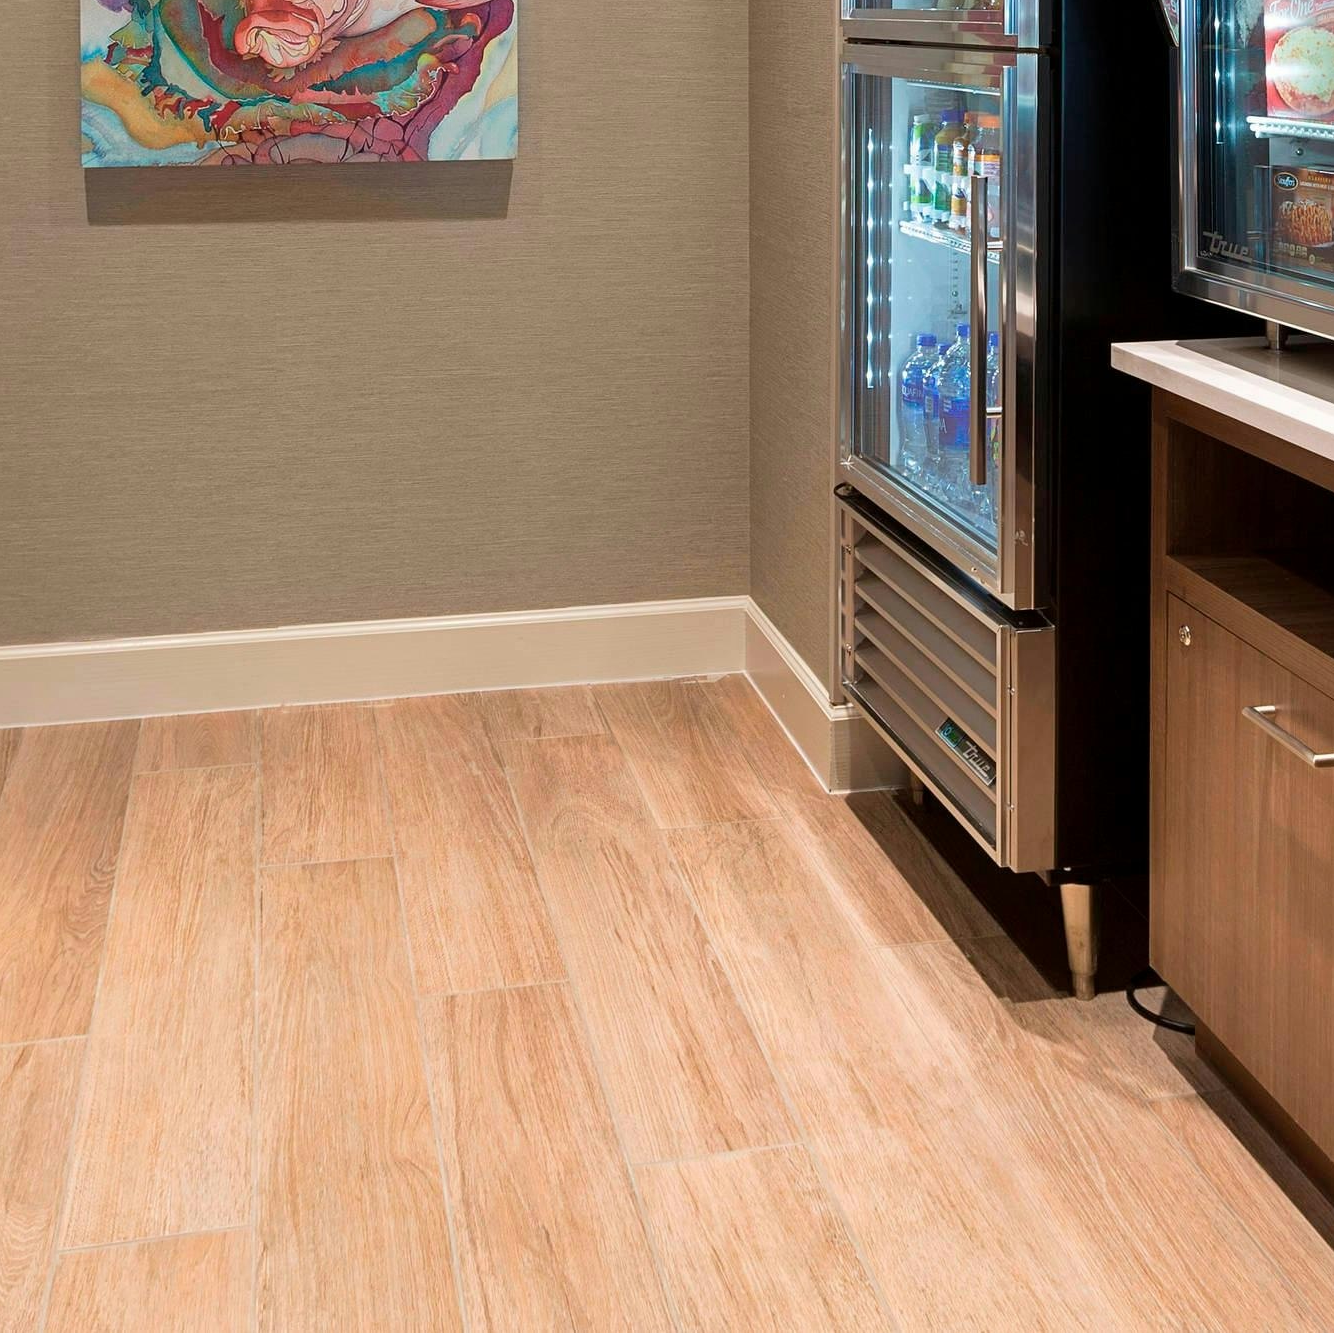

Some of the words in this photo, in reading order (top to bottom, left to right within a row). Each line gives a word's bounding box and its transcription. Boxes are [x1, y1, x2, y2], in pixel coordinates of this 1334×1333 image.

[1203, 231, 1252, 264] True
[901, 385, 924, 398] QUAFIN
[962, 739, 992, 776] True
